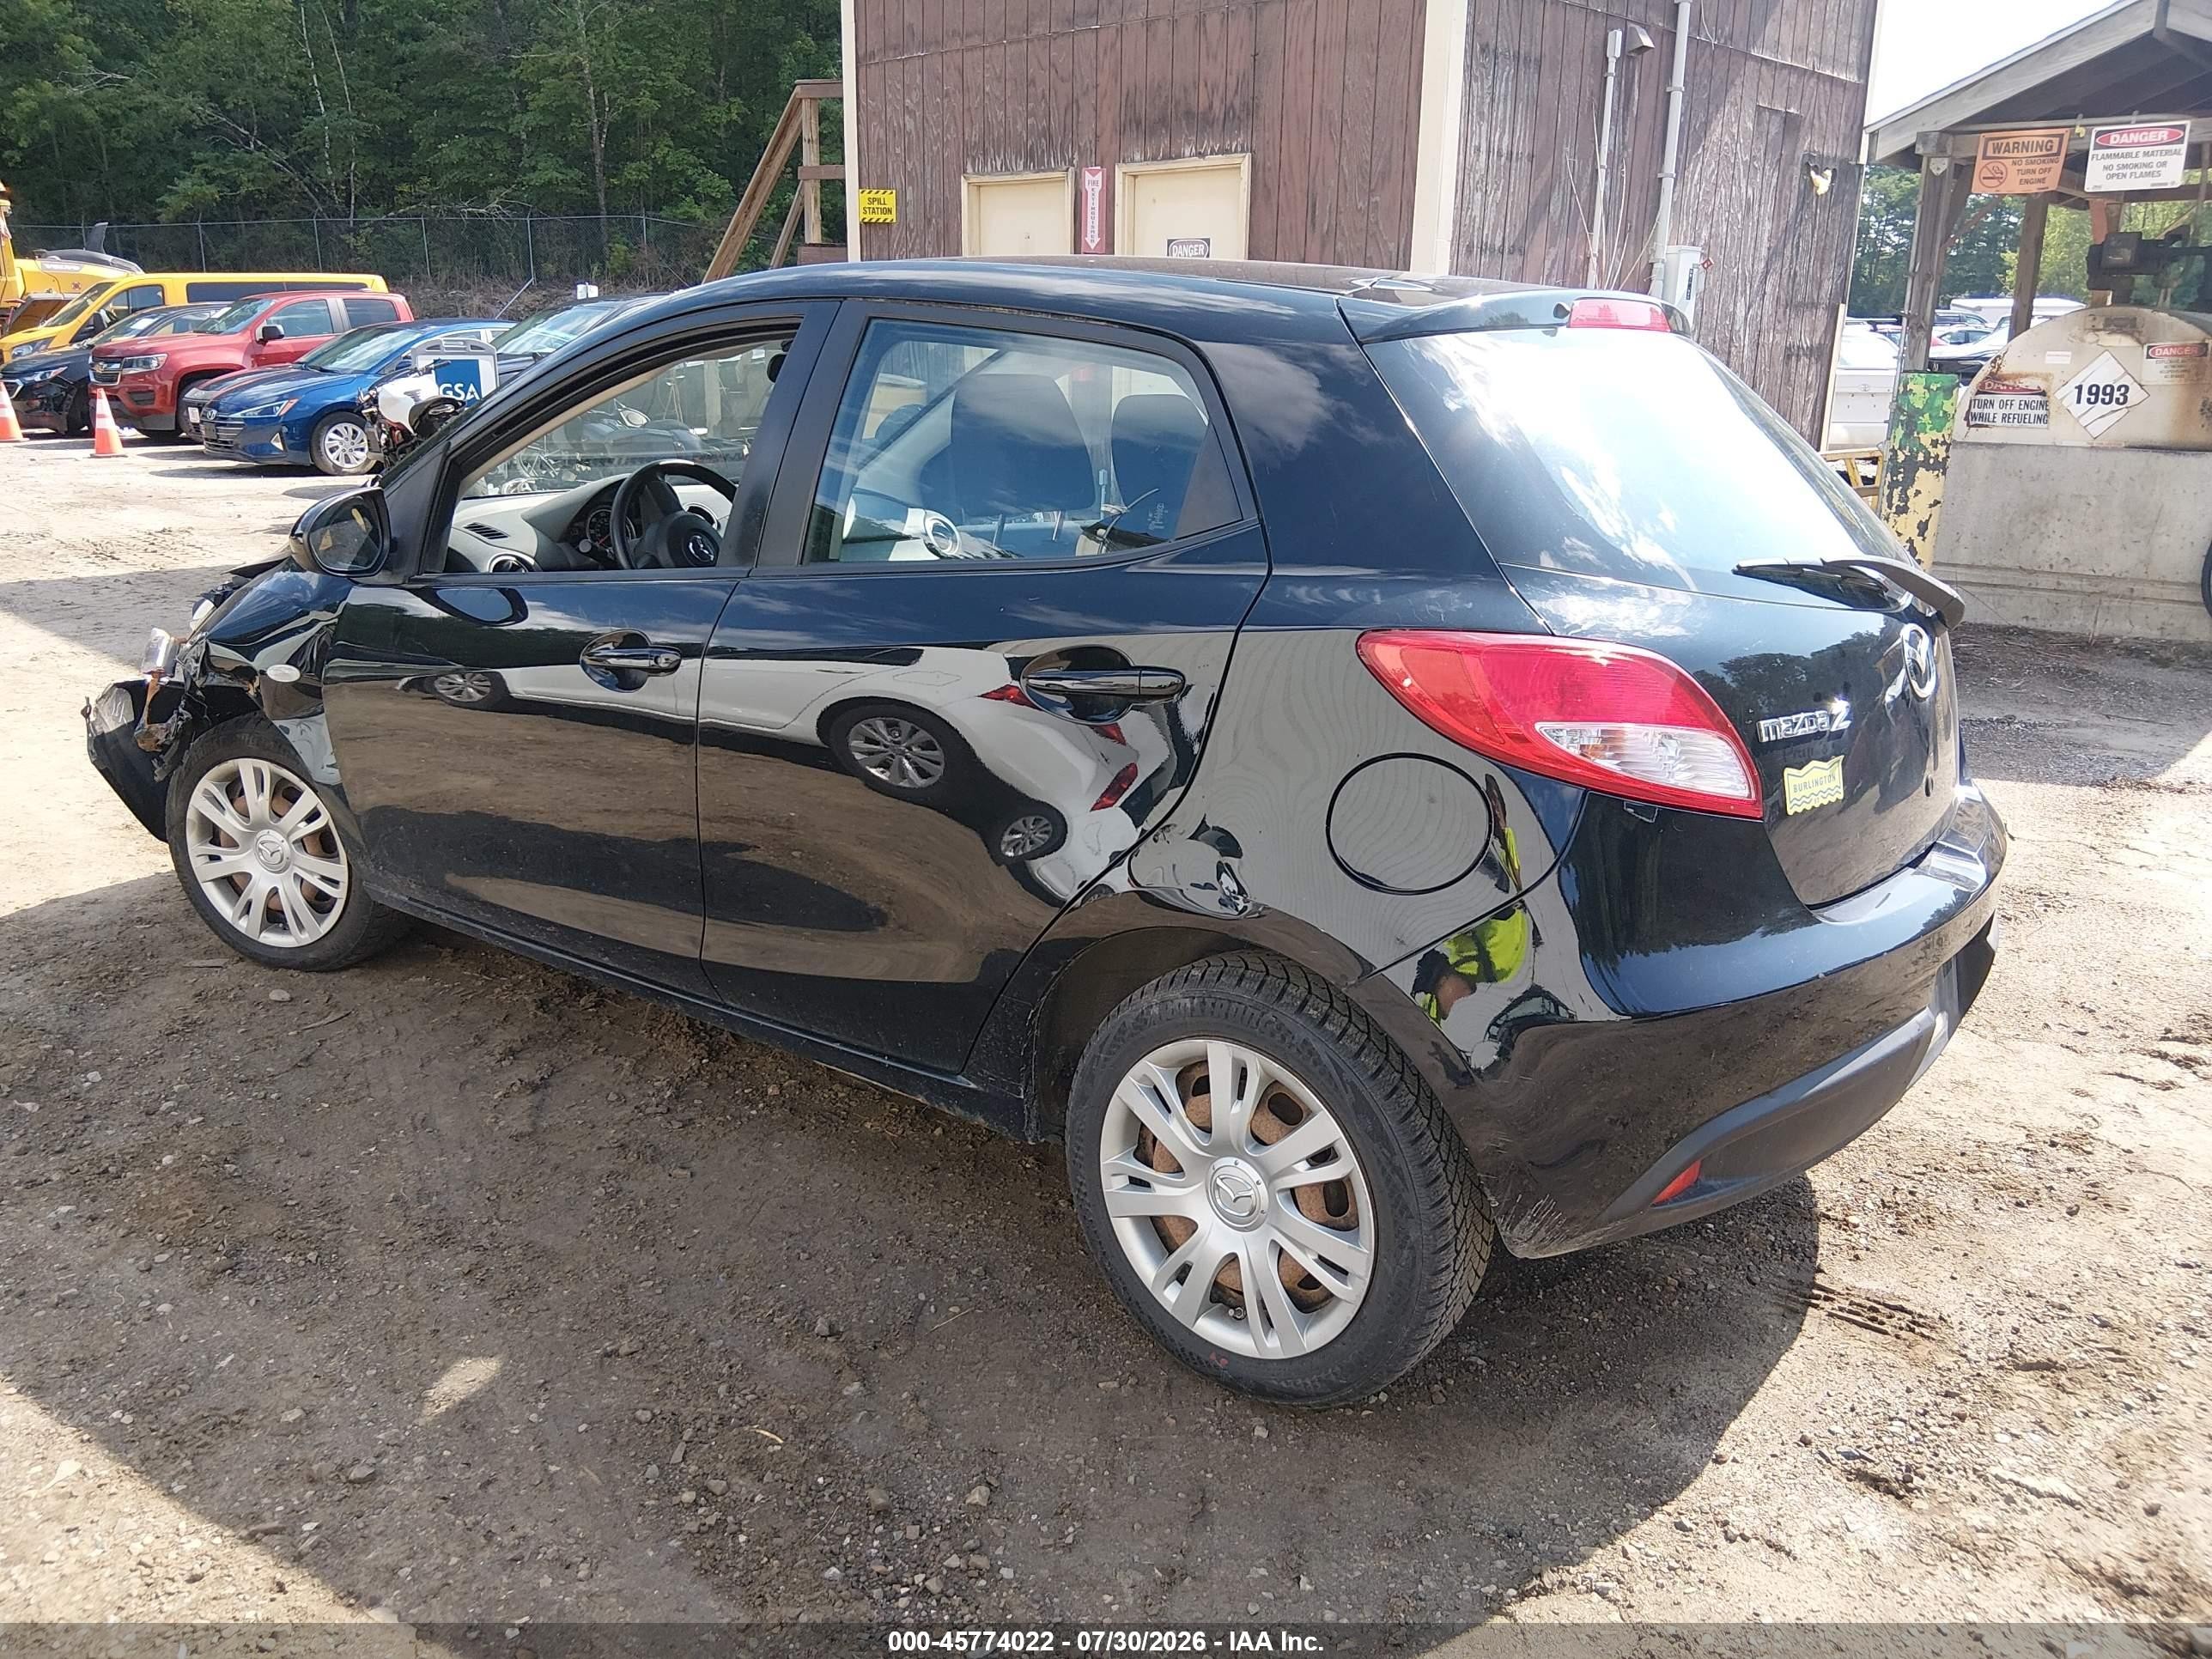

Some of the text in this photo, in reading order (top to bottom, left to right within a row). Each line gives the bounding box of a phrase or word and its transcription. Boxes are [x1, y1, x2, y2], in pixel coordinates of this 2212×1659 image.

[2109, 131, 2169, 144] DANGER
[1992, 139, 2054, 155] WARNING
[2091, 149, 2183, 161] FLAMMABLE MATERIAL
[2025, 157, 2060, 166] SMOKING
[2116, 161, 2154, 171] SMOKING
[2019, 177, 2047, 185] ENGINE
[862, 206, 893, 215] STATION
[1172, 244, 1205, 258] DANGER
[2155, 346, 2198, 356] DANGER
[439, 383, 480, 400] GSA
[2074, 383, 2130, 405] 1993
[1972, 398, 2050, 410] TURN OFF ENGINE
[1970, 412, 2048, 424] WHILE REFUELING
[1793, 773, 1836, 793] BURLINGTON
